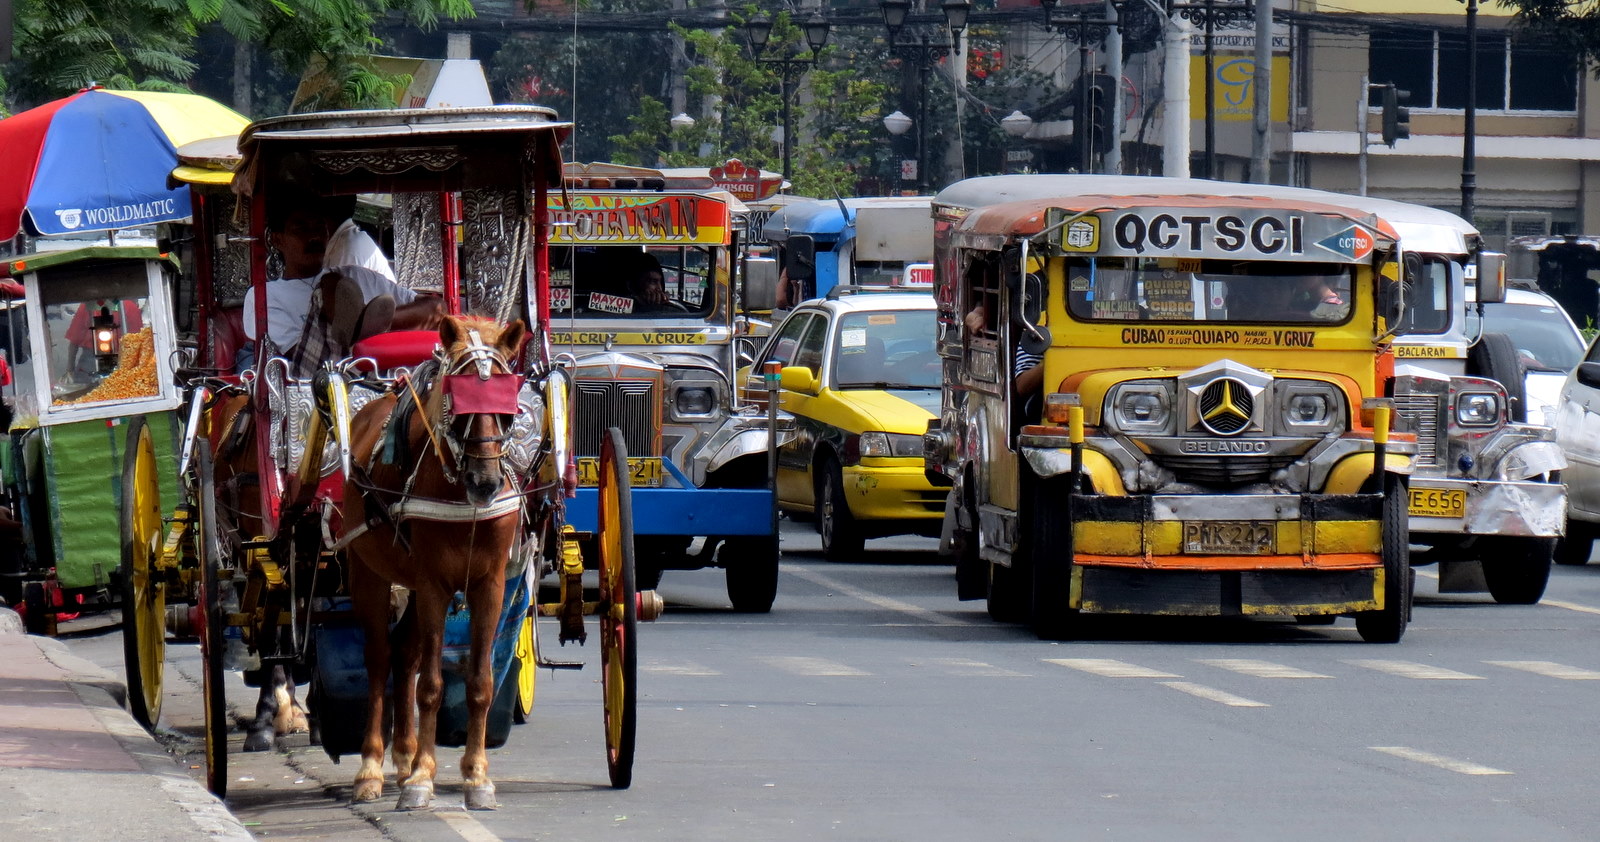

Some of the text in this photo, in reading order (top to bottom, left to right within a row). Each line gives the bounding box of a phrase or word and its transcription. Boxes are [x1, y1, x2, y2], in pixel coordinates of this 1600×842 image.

[85, 198, 174, 225] WORLDMATIC
[1114, 213, 1304, 255] QCTSCI
[1339, 237, 1368, 250] QCTSCI
[1179, 260, 1200, 272] 2011
[591, 292, 632, 309] MAYON
[1150, 301, 1194, 313] CUBAO
[1121, 328, 1165, 344] CUBAO
[1192, 330, 1239, 345] QUIAPO
[1398, 346, 1446, 357] BACLARAN
[1185, 441, 1266, 453] BELANDO
[1230, 526, 1270, 545] 242
